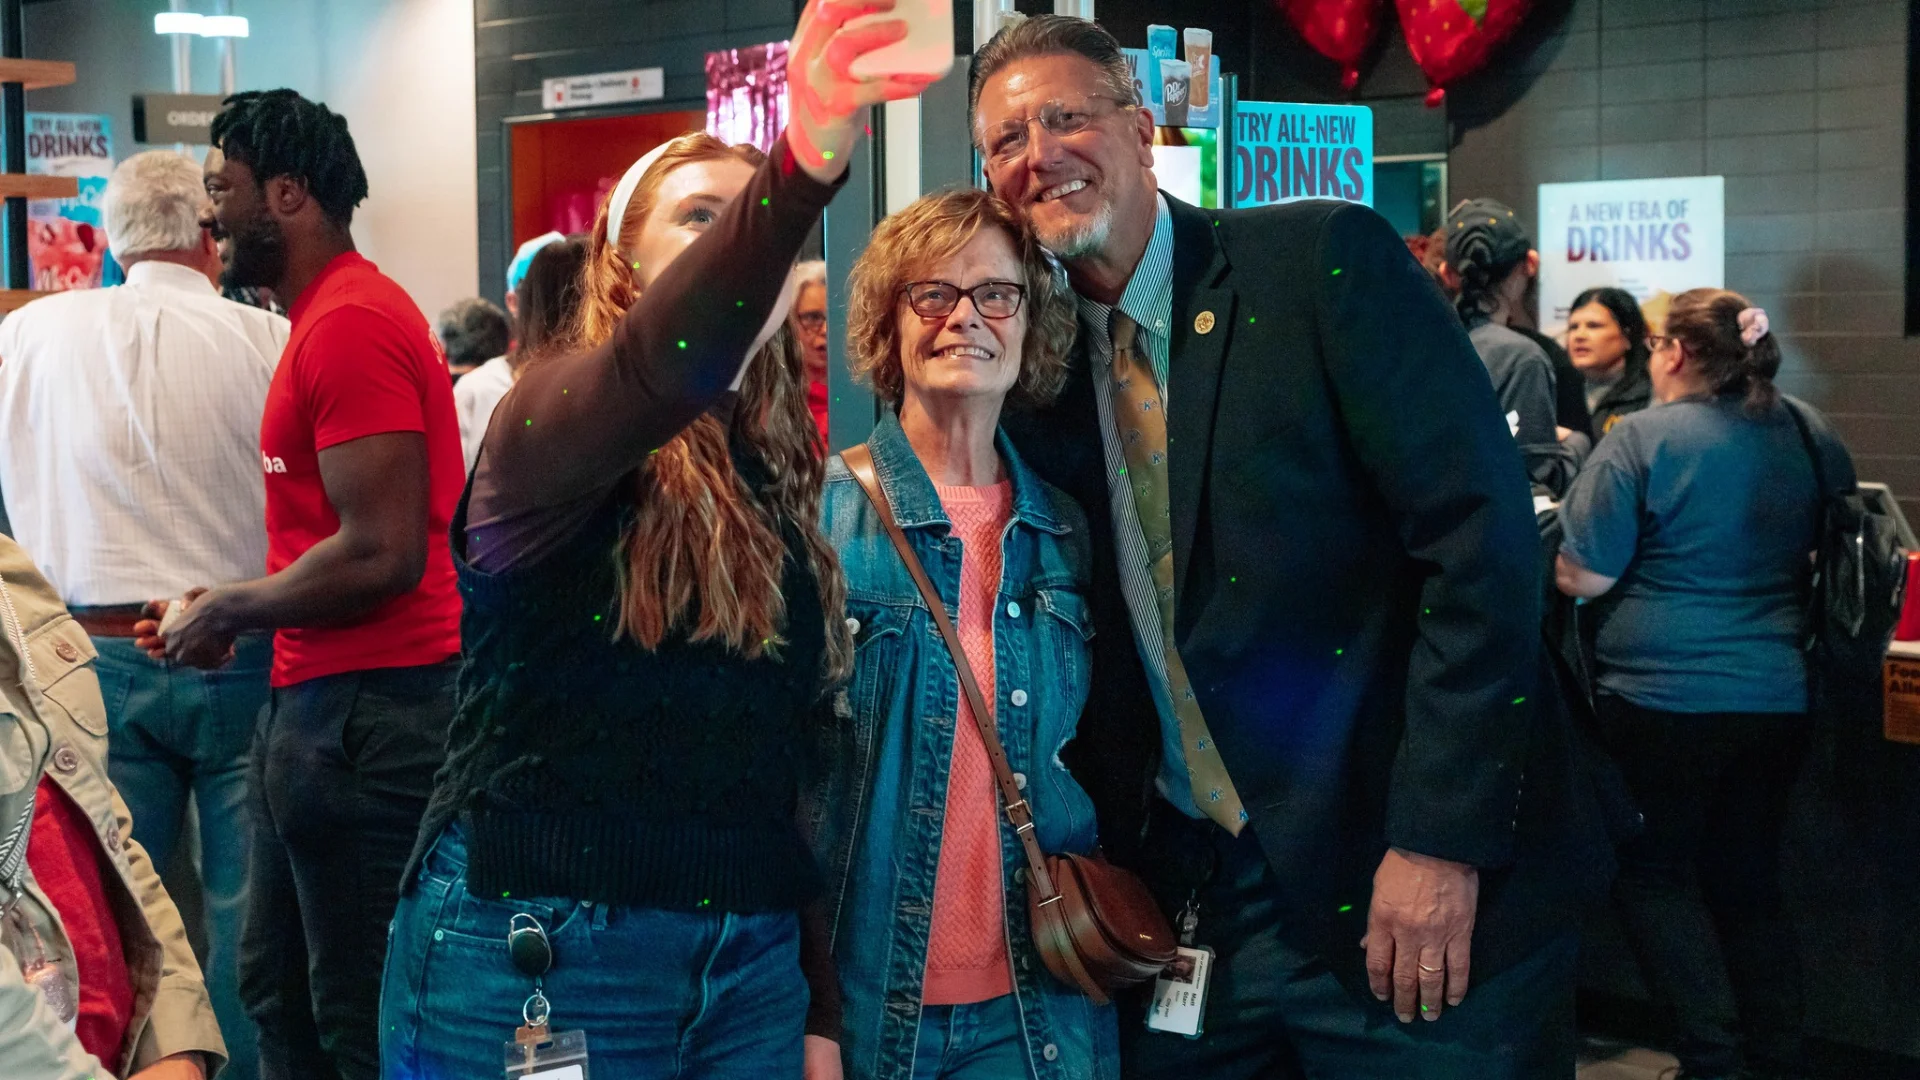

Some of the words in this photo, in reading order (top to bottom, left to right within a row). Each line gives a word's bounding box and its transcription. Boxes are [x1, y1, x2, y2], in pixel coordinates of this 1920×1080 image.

[1165, 83, 1186, 103] Pepper
[1237, 112, 1273, 142] TRY
[1277, 113, 1357, 145] ALL-NEW
[28, 133, 108, 159] DRINKS
[1237, 145, 1365, 203] DRINKS
[1569, 203, 1581, 222] A
[1586, 201, 1623, 221] NEW
[1629, 200, 1662, 220] ERA
[1667, 198, 1690, 218] OF
[1567, 222, 1691, 262] DRINKS
